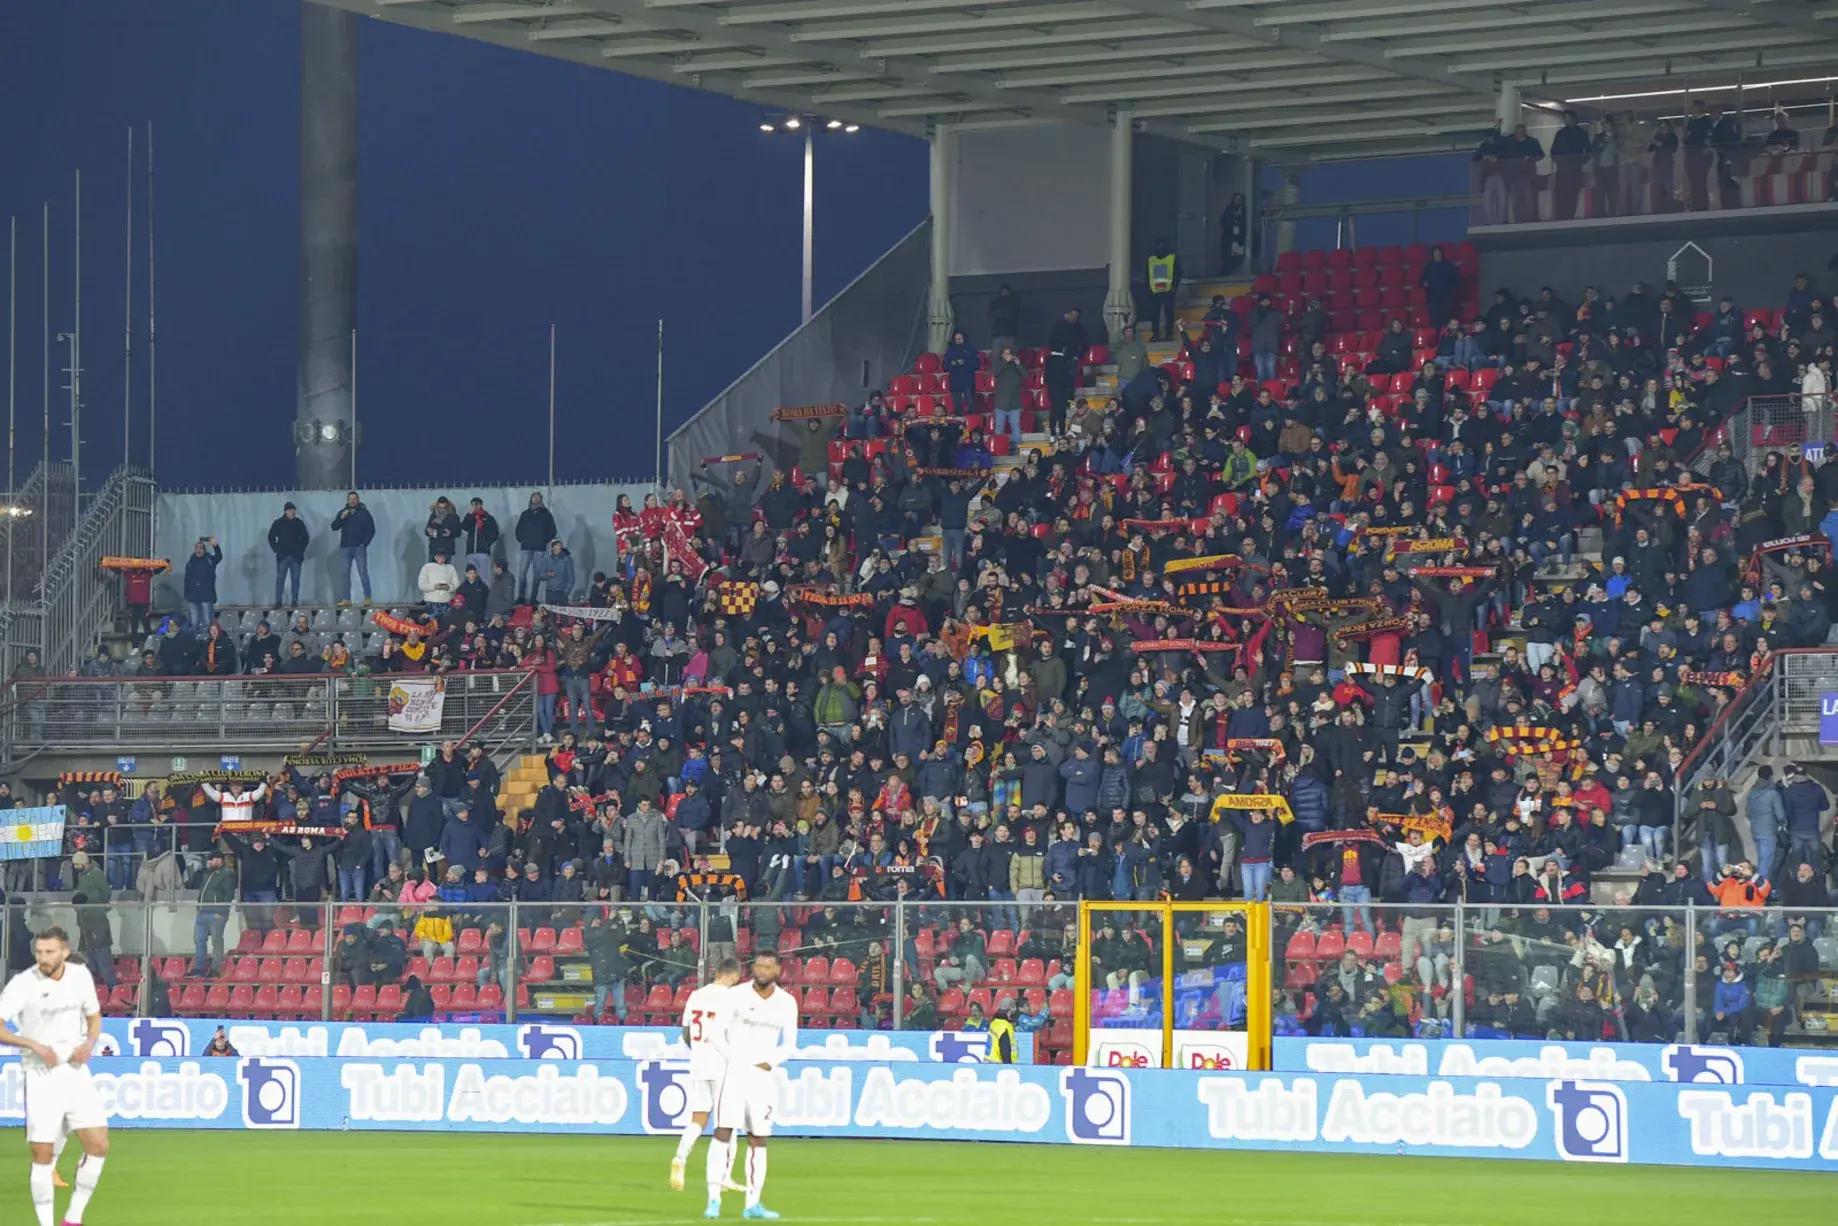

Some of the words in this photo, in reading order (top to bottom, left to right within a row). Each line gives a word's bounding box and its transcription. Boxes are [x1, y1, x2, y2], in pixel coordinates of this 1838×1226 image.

[588, 608, 609, 618] 1927
[887, 865, 914, 873] roma
[1108, 1050, 1148, 1068] Dole
[1191, 1052, 1231, 1070] Dole
[93, 1066, 224, 1114] cciaio
[346, 1067, 441, 1117] Tubi
[450, 1067, 624, 1120] Acciaio
[776, 1069, 847, 1123] ubi
[859, 1070, 1047, 1128] Acciaio
[1202, 1081, 1313, 1136] Tubi
[1325, 1083, 1530, 1144] Acciaio
[1682, 1094, 1808, 1154] Tubi
